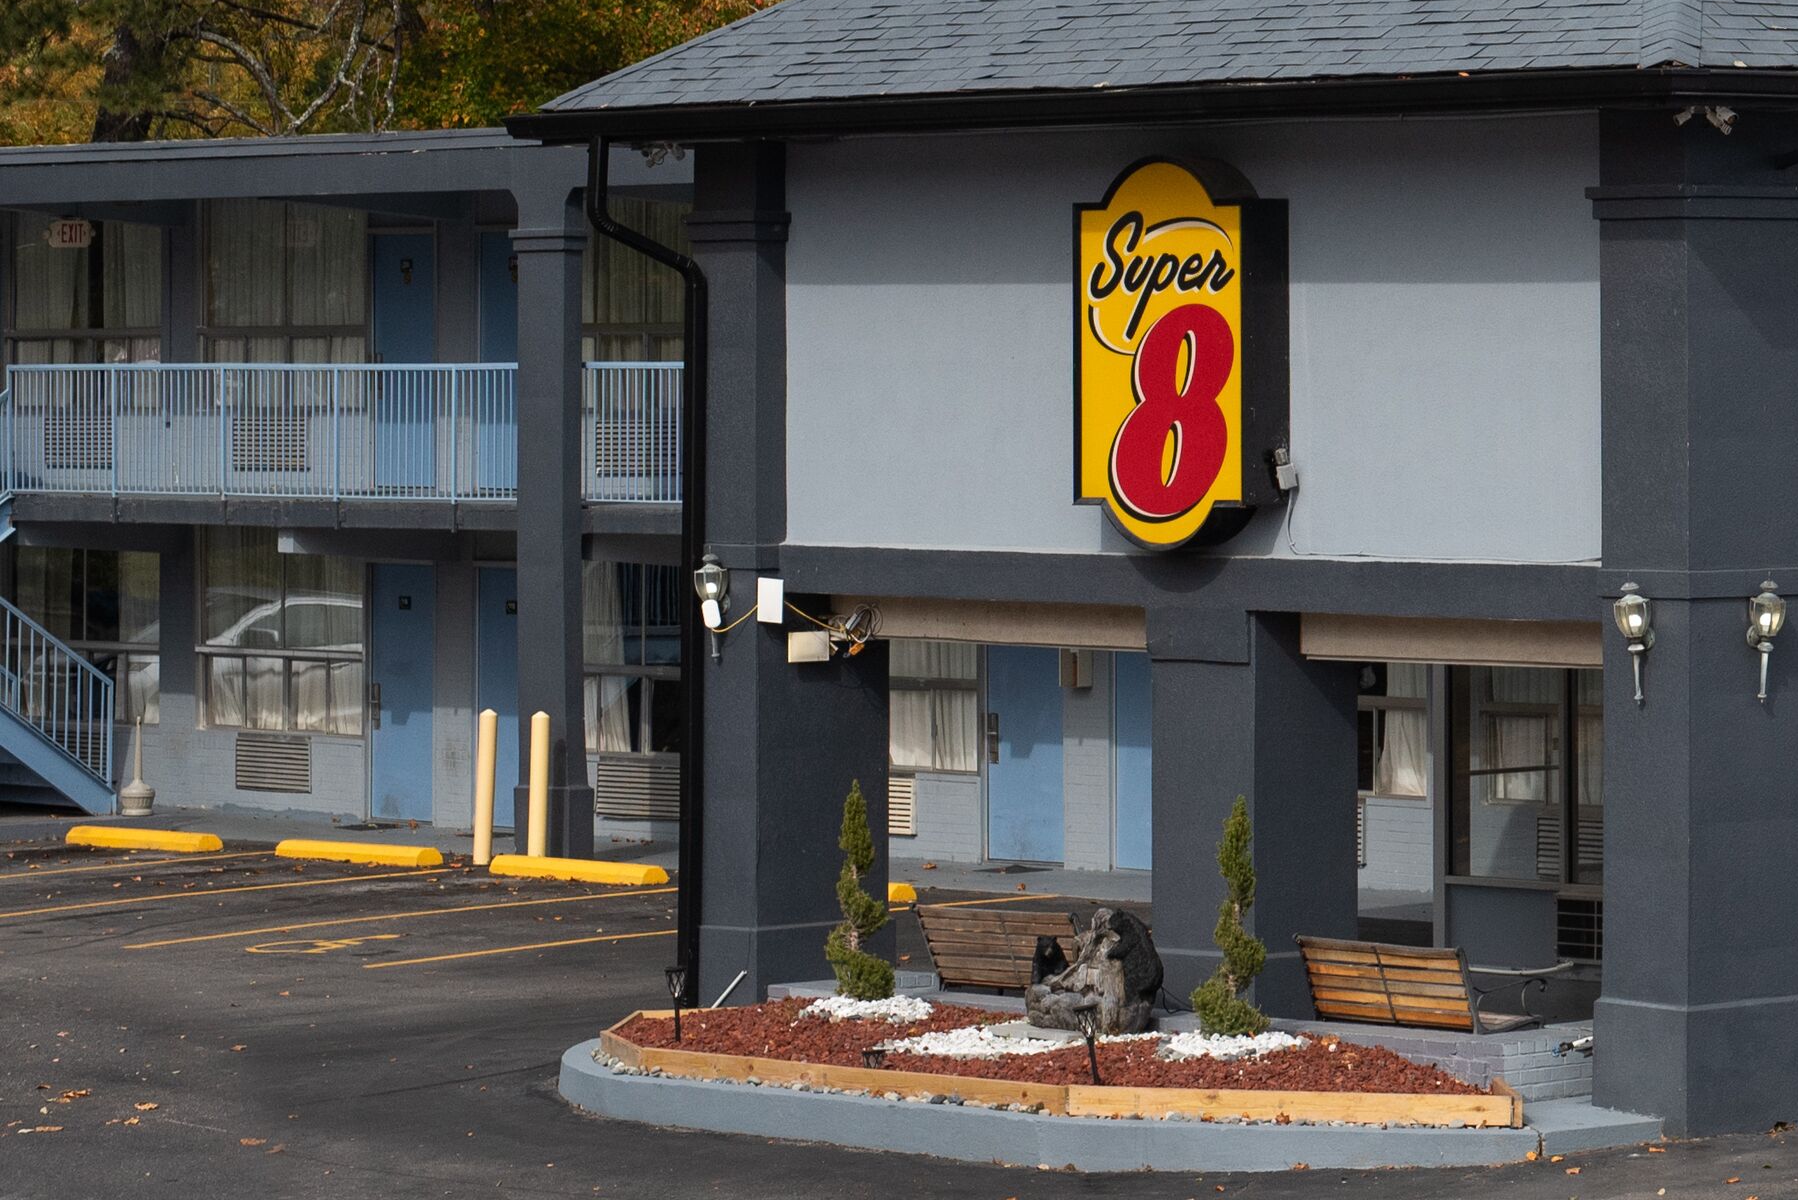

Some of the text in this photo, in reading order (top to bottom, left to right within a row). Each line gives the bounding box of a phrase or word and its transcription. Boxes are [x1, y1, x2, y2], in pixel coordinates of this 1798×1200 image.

[61, 223, 84, 244] EXIT
[1087, 210, 1236, 342] Super
[1107, 303, 1235, 523] 8
